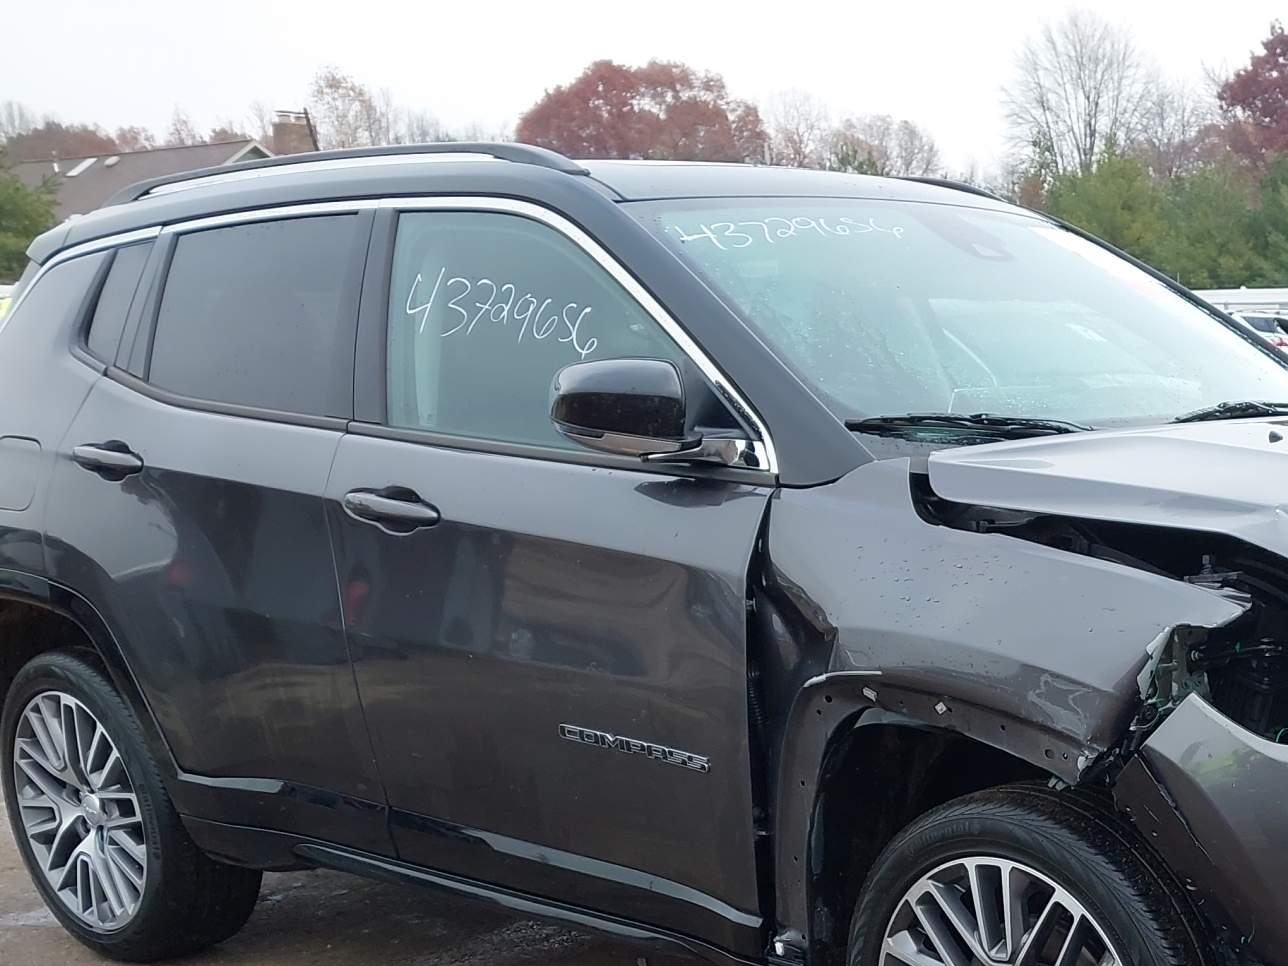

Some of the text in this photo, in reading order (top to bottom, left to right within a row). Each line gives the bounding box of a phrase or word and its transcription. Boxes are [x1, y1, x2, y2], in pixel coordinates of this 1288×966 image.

[675, 216, 905, 250] 43729656
[406, 266, 598, 360] 43729656
[558, 723, 711, 773] COMPASS
